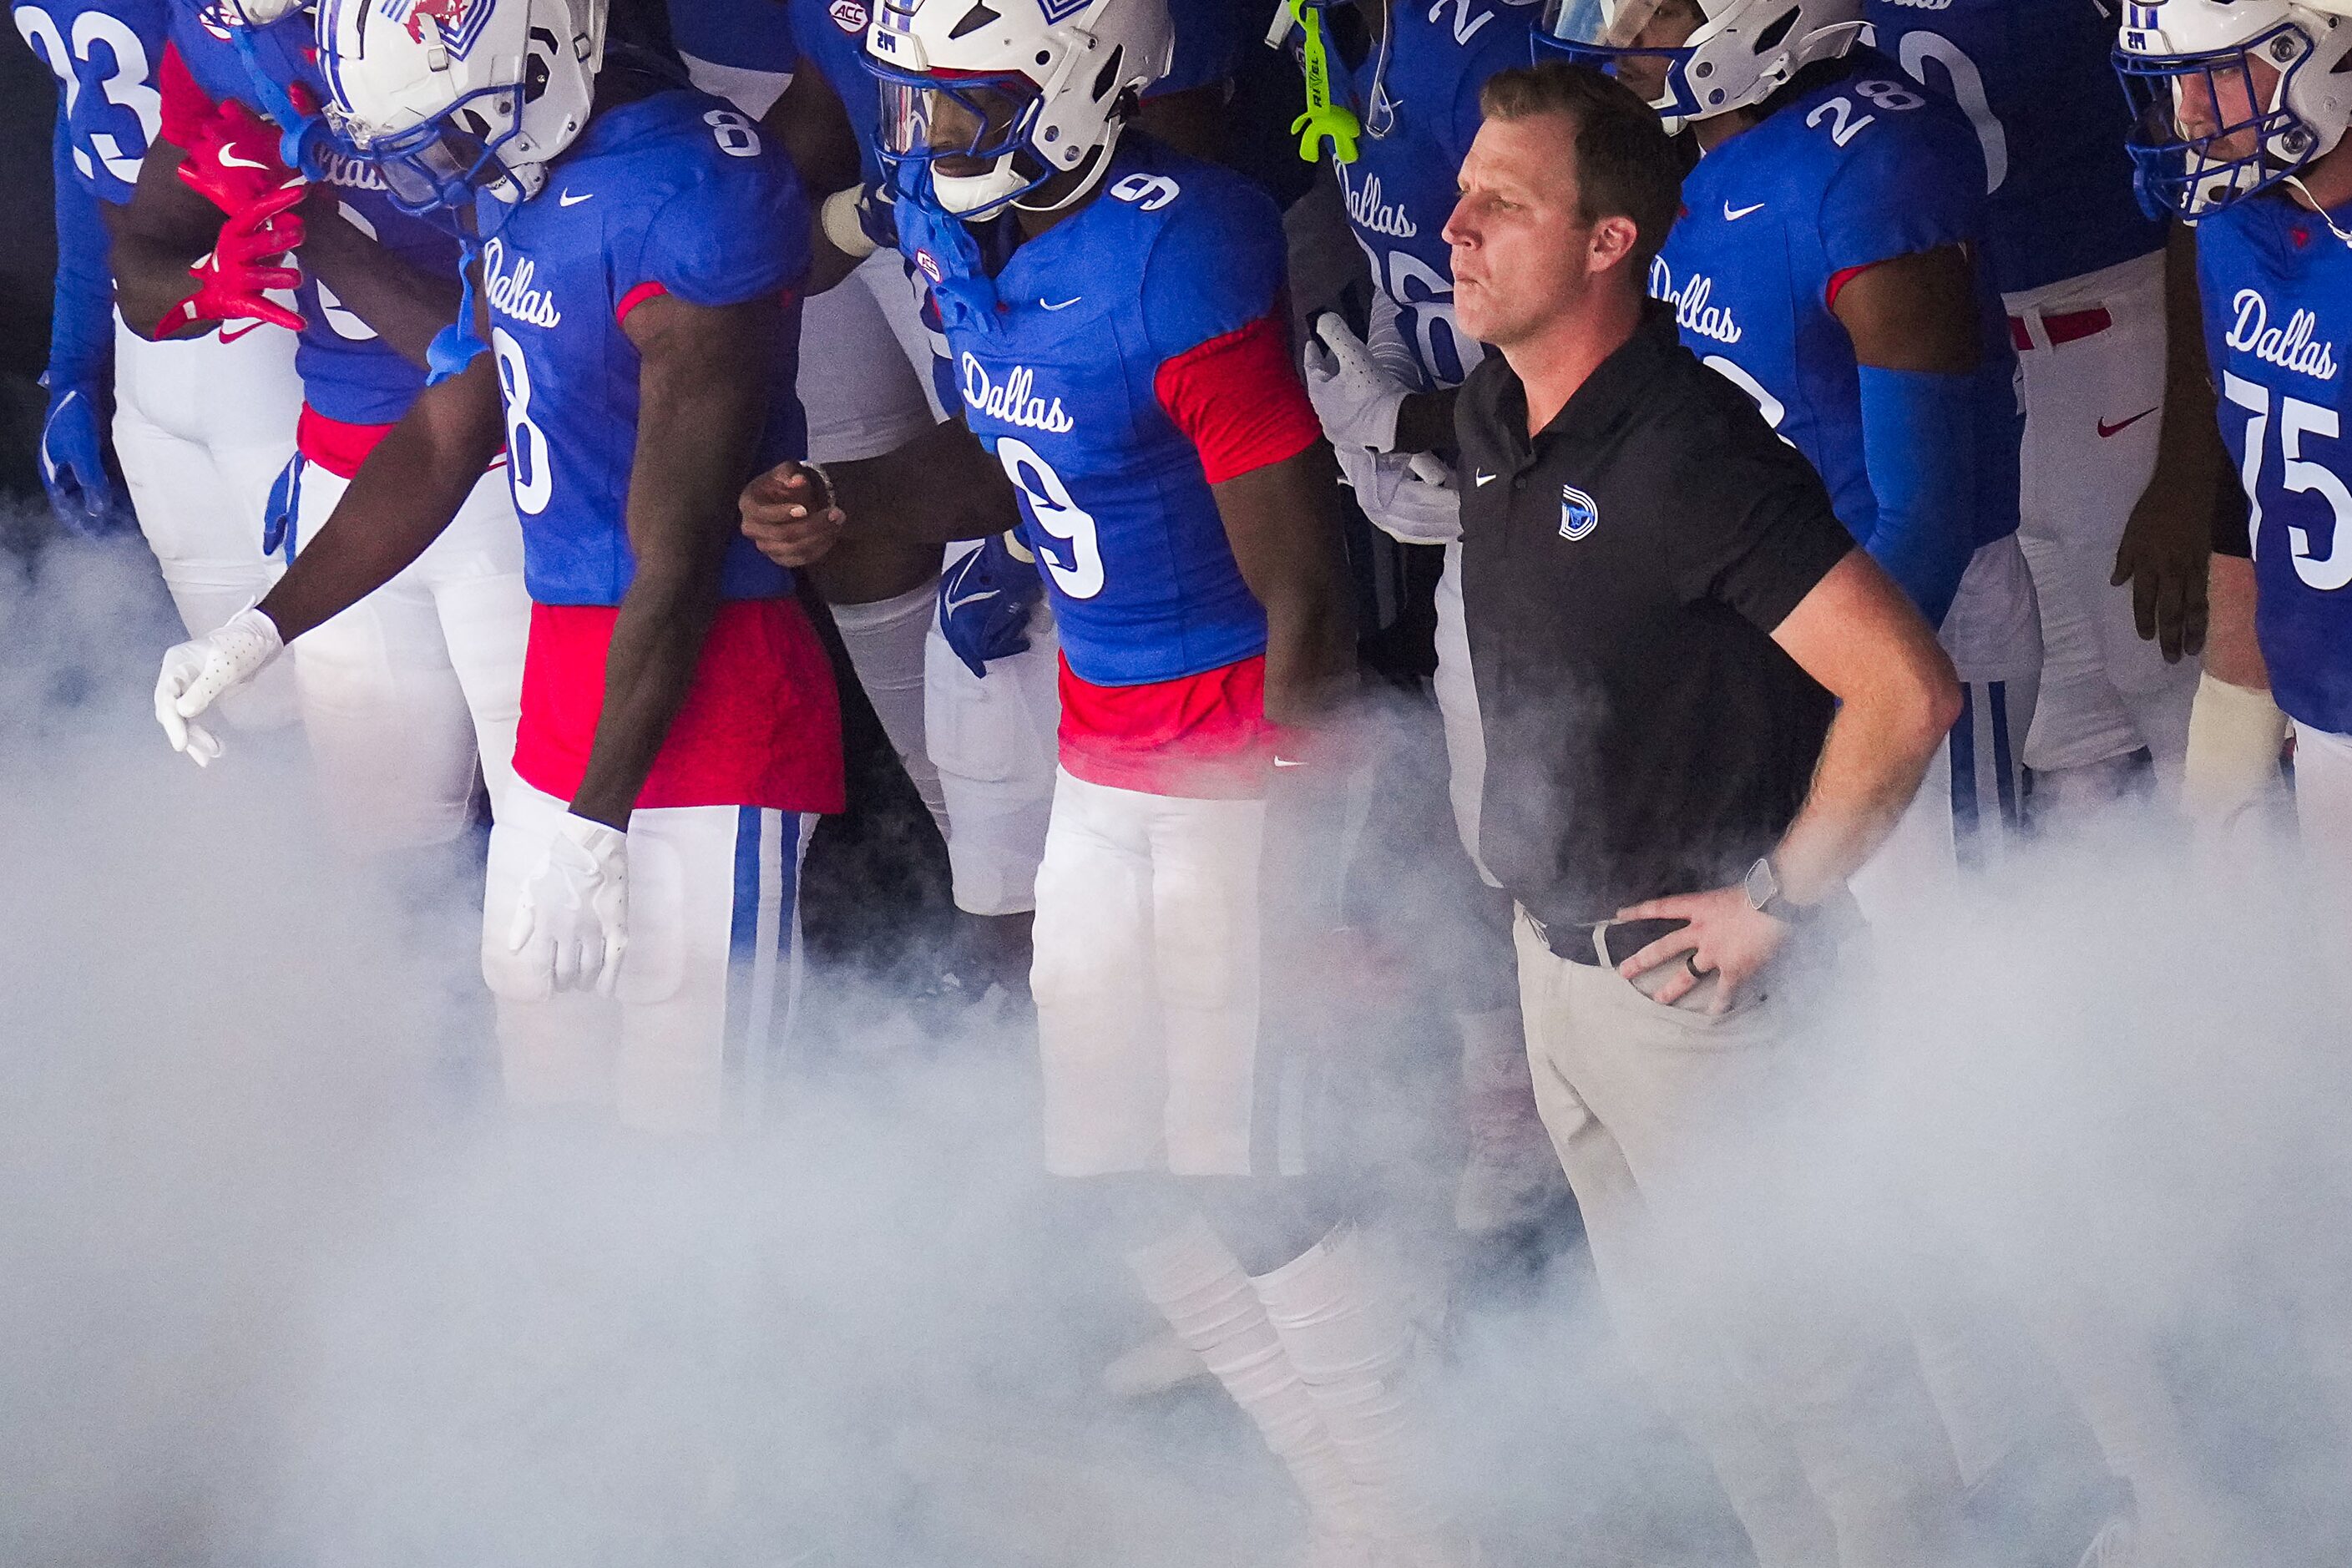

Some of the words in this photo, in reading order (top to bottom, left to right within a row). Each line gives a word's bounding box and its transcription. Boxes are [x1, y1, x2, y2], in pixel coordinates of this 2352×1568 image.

[834, 4, 864, 22] ACC
[703, 109, 761, 157] 8
[1806, 80, 1925, 147] 28
[1110, 173, 1180, 210] 9
[483, 236, 561, 328] Dallas
[2225, 288, 2338, 381] Dallas
[493, 326, 553, 514] 8
[962, 351, 1075, 433] Dallas
[997, 437, 1105, 599] 9
[2223, 369, 2352, 591] 75
